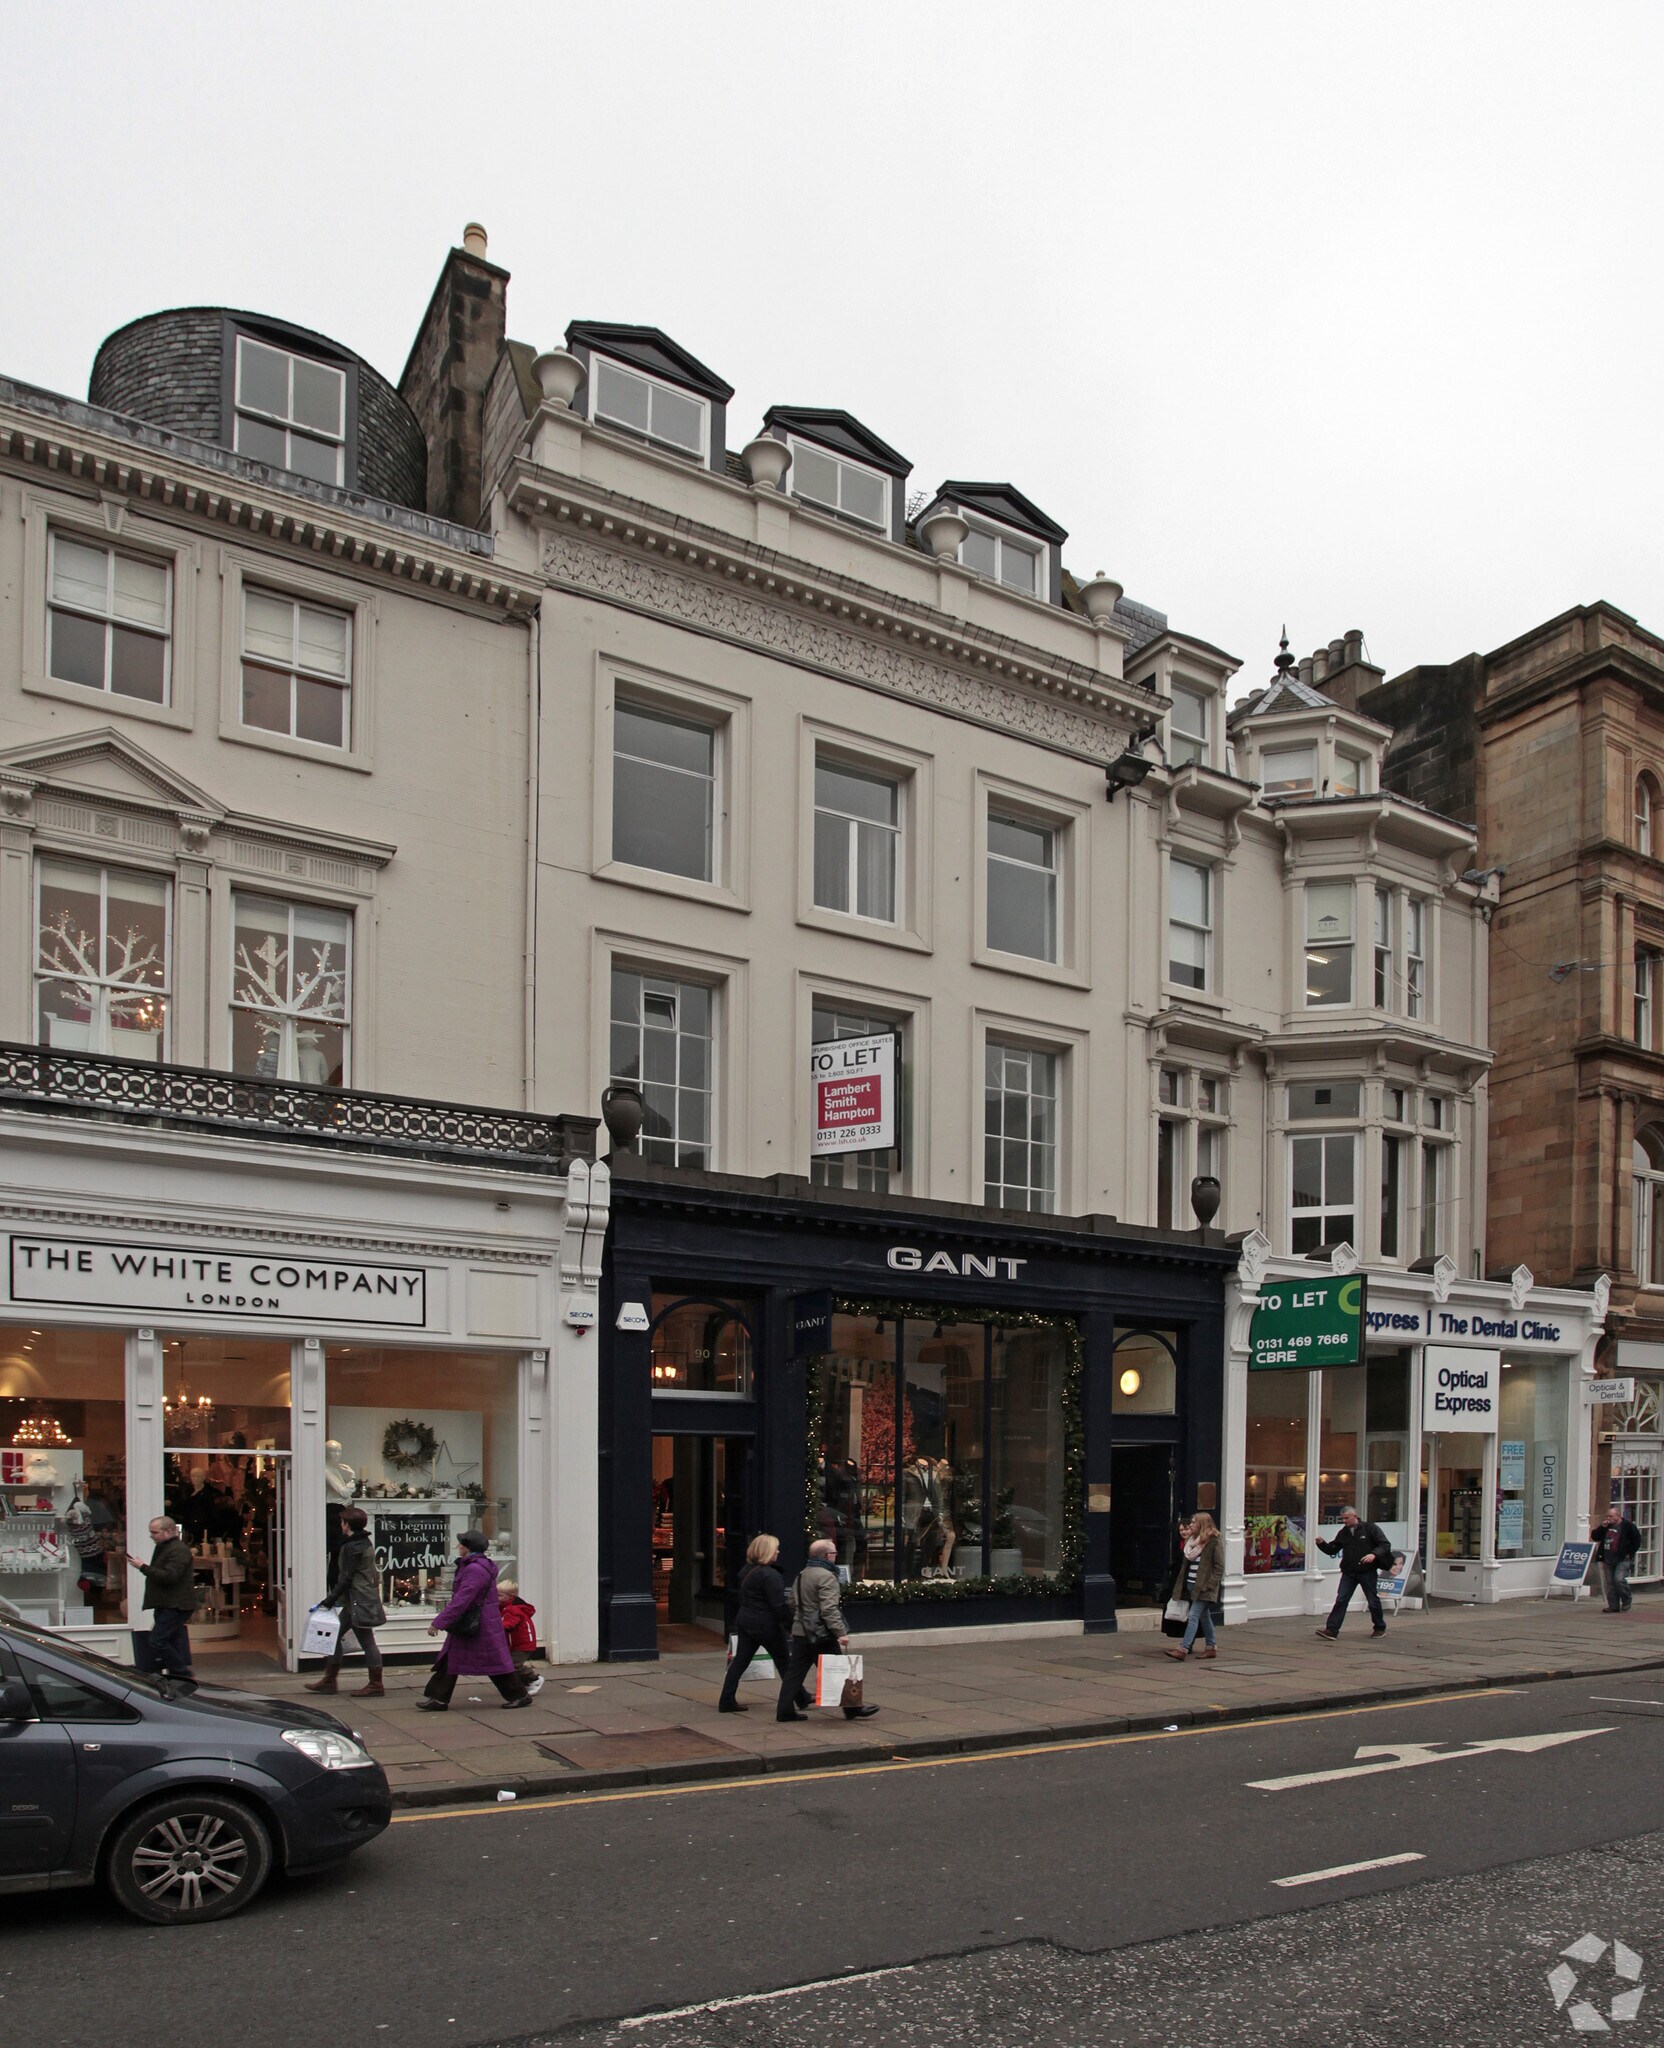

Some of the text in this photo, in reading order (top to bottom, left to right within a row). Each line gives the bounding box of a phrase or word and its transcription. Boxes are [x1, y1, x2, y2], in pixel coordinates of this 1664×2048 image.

[848, 1039, 869, 1048] OFFICE
[872, 1037, 893, 1045] SUITES
[811, 1047, 881, 1072] TO LET
[824, 1082, 871, 1097] Lambert
[825, 1095, 857, 1109] Smith
[824, 1107, 875, 1121] Hampton
[817, 1125, 881, 1140] 0131 226 0333
[817, 1136, 867, 1147] www.lsh.co.uk
[886, 1246, 1028, 1280] GANT
[19, 1245, 419, 1296] THE WHITE COMPANY
[186, 1292, 280, 1308] LONDON
[1260, 1291, 1328, 1311] TO LET
[623, 1316, 646, 1324] SECOM
[795, 1316, 827, 1330] GANT
[1366, 1311, 1561, 1342] xpress The Dental Clinic
[1256, 1333, 1348, 1350] 0131 469 7666
[695, 1349, 711, 1358] 90
[1256, 1350, 1297, 1364] CBRE
[1438, 1368, 1488, 1391] Optical
[1589, 1383, 1616, 1392] Optical
[1600, 1391, 1625, 1399] Dental
[1435, 1392, 1491, 1415] Express
[1502, 1444, 1524, 1455] FREE
[1541, 1456, 1556, 1542] Dental Clinic
[400, 1521, 452, 1533] beginnin
[390, 1535, 402, 1543] to
[405, 1533, 429, 1543] look
[440, 1533, 450, 1543] lo
[374, 1544, 457, 1573] Christma
[1562, 1549, 1588, 1560] Free
[920, 1566, 966, 1578] GANT
